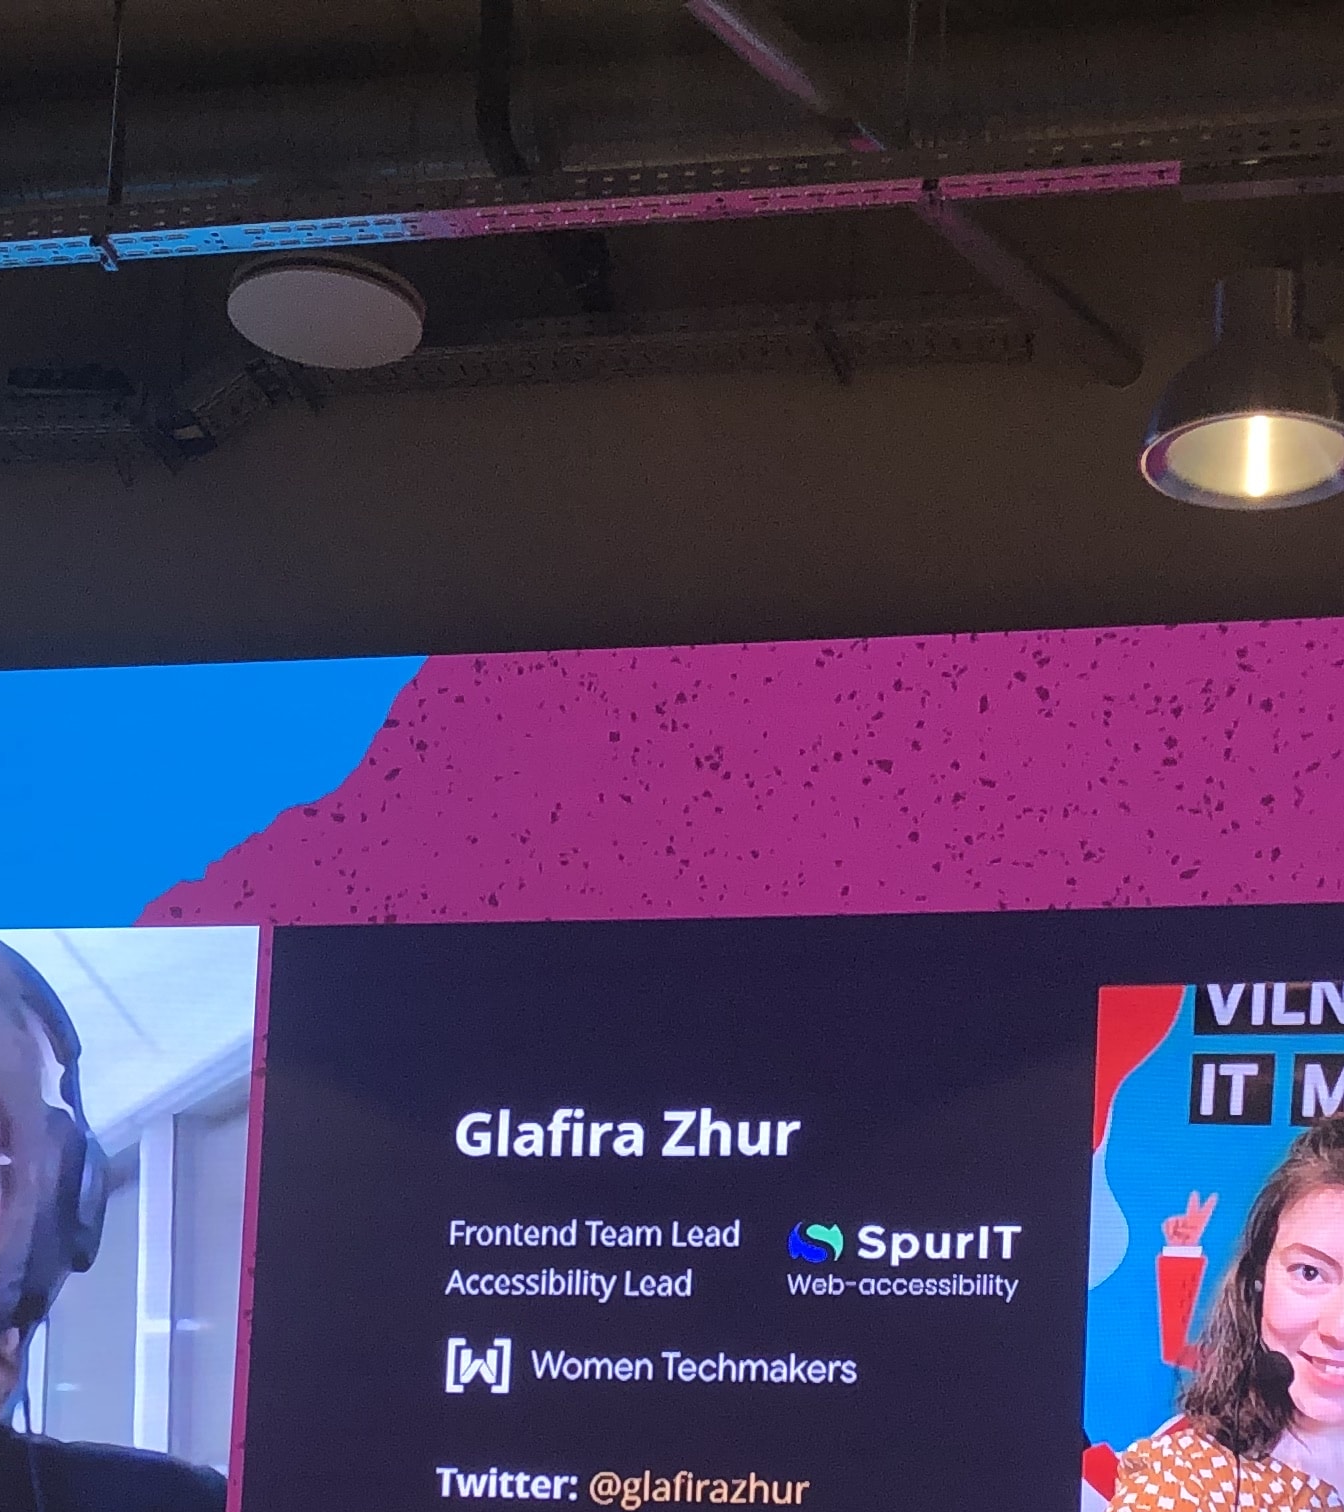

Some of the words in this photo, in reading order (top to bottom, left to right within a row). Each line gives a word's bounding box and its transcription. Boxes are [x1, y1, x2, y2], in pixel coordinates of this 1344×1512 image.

[1199, 1063, 1259, 1117] IT
[455, 1108, 645, 1158] Glafira
[661, 1107, 802, 1158] Zhur
[449, 1218, 577, 1247] Frontend
[584, 1220, 662, 1248] Team
[671, 1219, 740, 1248] Lead
[857, 1224, 1023, 1267] SpurIT
[444, 1267, 618, 1304] Accessibility
[624, 1268, 693, 1297] Lead
[787, 1273, 1019, 1303] Web-accessibility
[531, 1349, 654, 1382] Women
[661, 1351, 858, 1385] Techmakers
[435, 1467, 578, 1501] Twitter:
[589, 1469, 811, 1511] @glafirazhur
